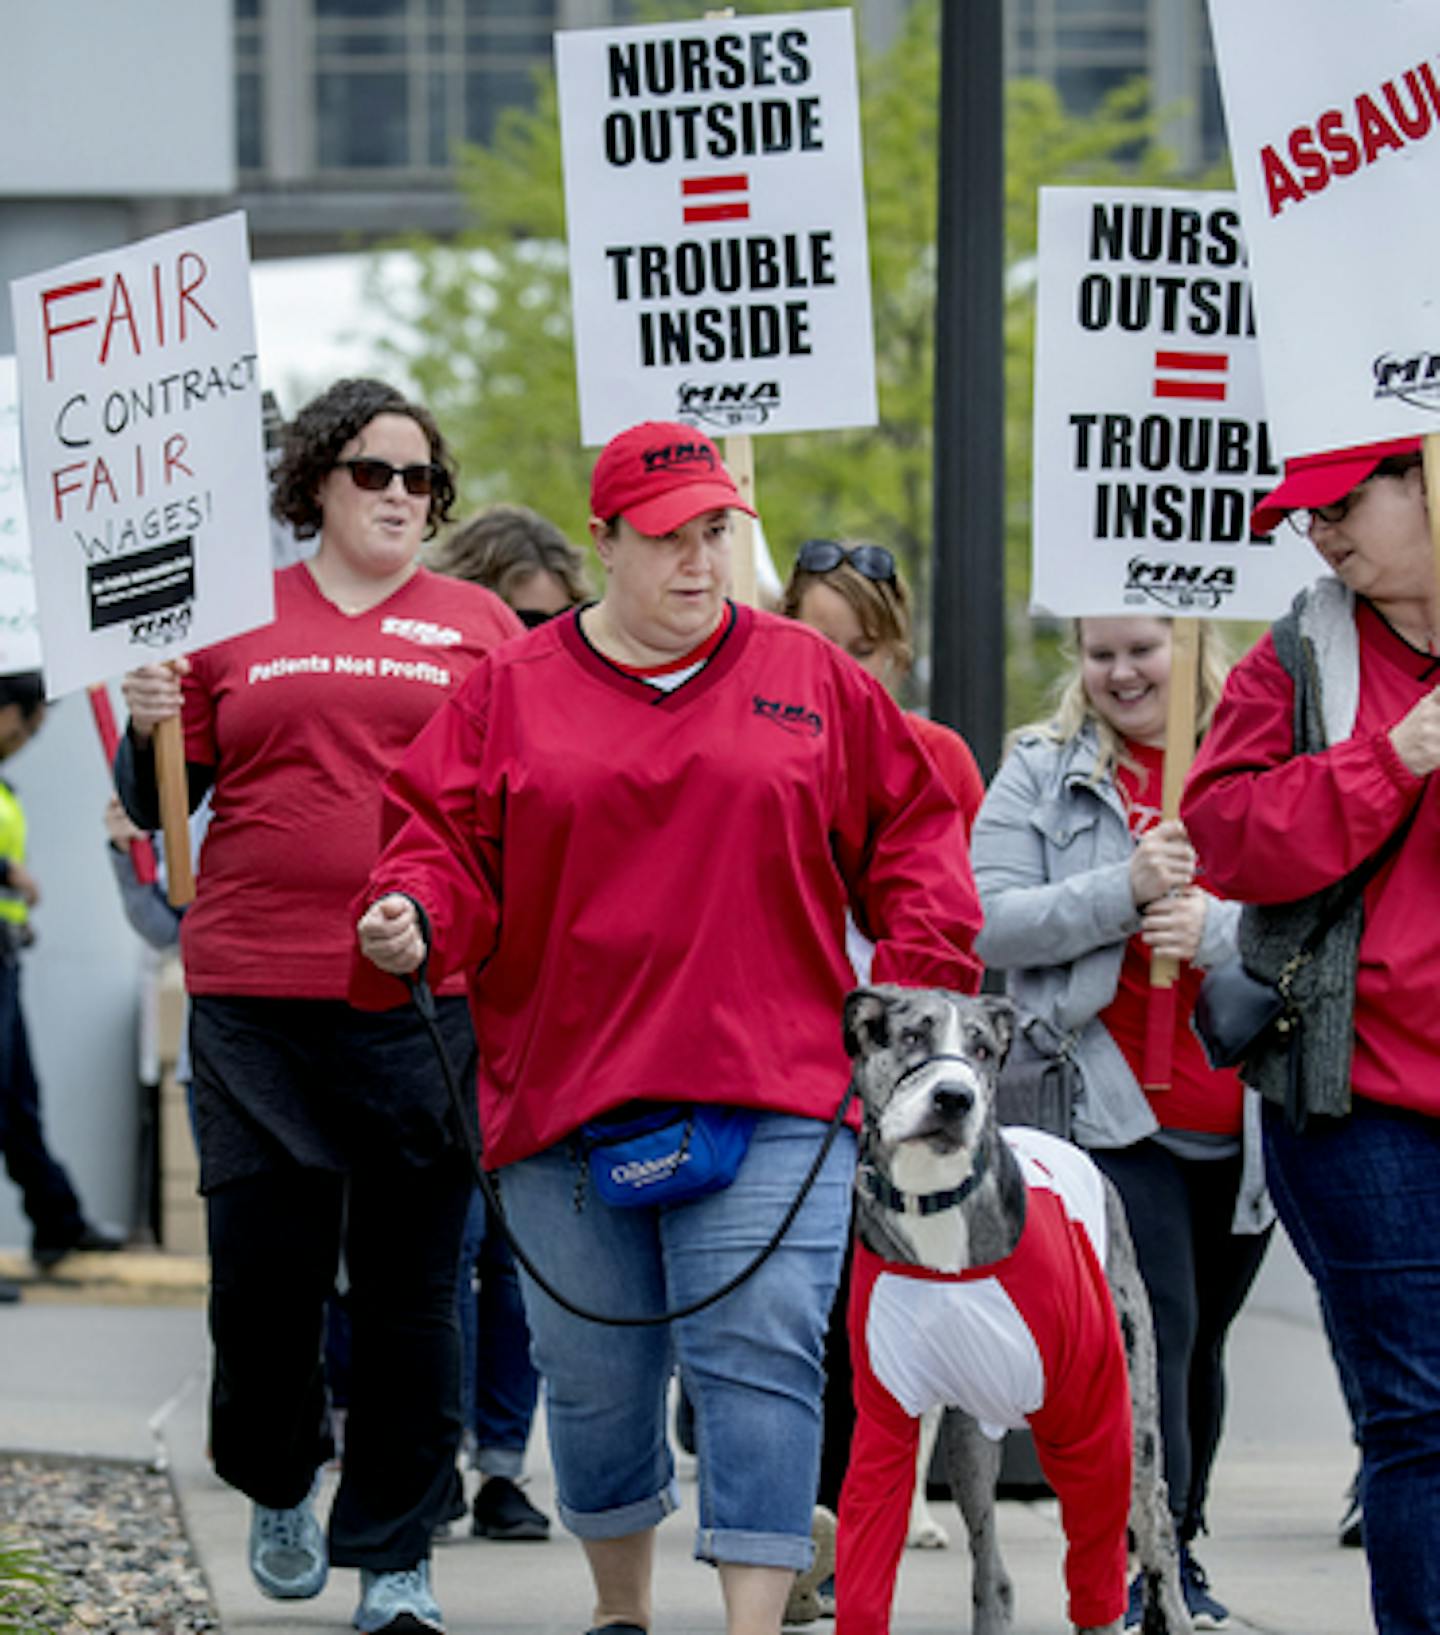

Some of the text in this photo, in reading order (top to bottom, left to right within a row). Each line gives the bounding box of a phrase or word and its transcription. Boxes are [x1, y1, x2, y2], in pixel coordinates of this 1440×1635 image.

[607, 30, 812, 98] NURSES
[604, 96, 824, 166] OUTSIDE
[606, 231, 836, 300] TROUBLE
[1089, 203, 1249, 267] NURS
[40, 252, 218, 382] FAIR
[640, 301, 812, 367] INSIDE
[56, 354, 259, 448] CONTRACT
[677, 381, 781, 406] MNA
[1069, 413, 1279, 475] TROUBL
[51, 433, 194, 523] FAIR
[75, 492, 212, 559] WAGES!
[248, 654, 451, 687] Patients Not Profits
